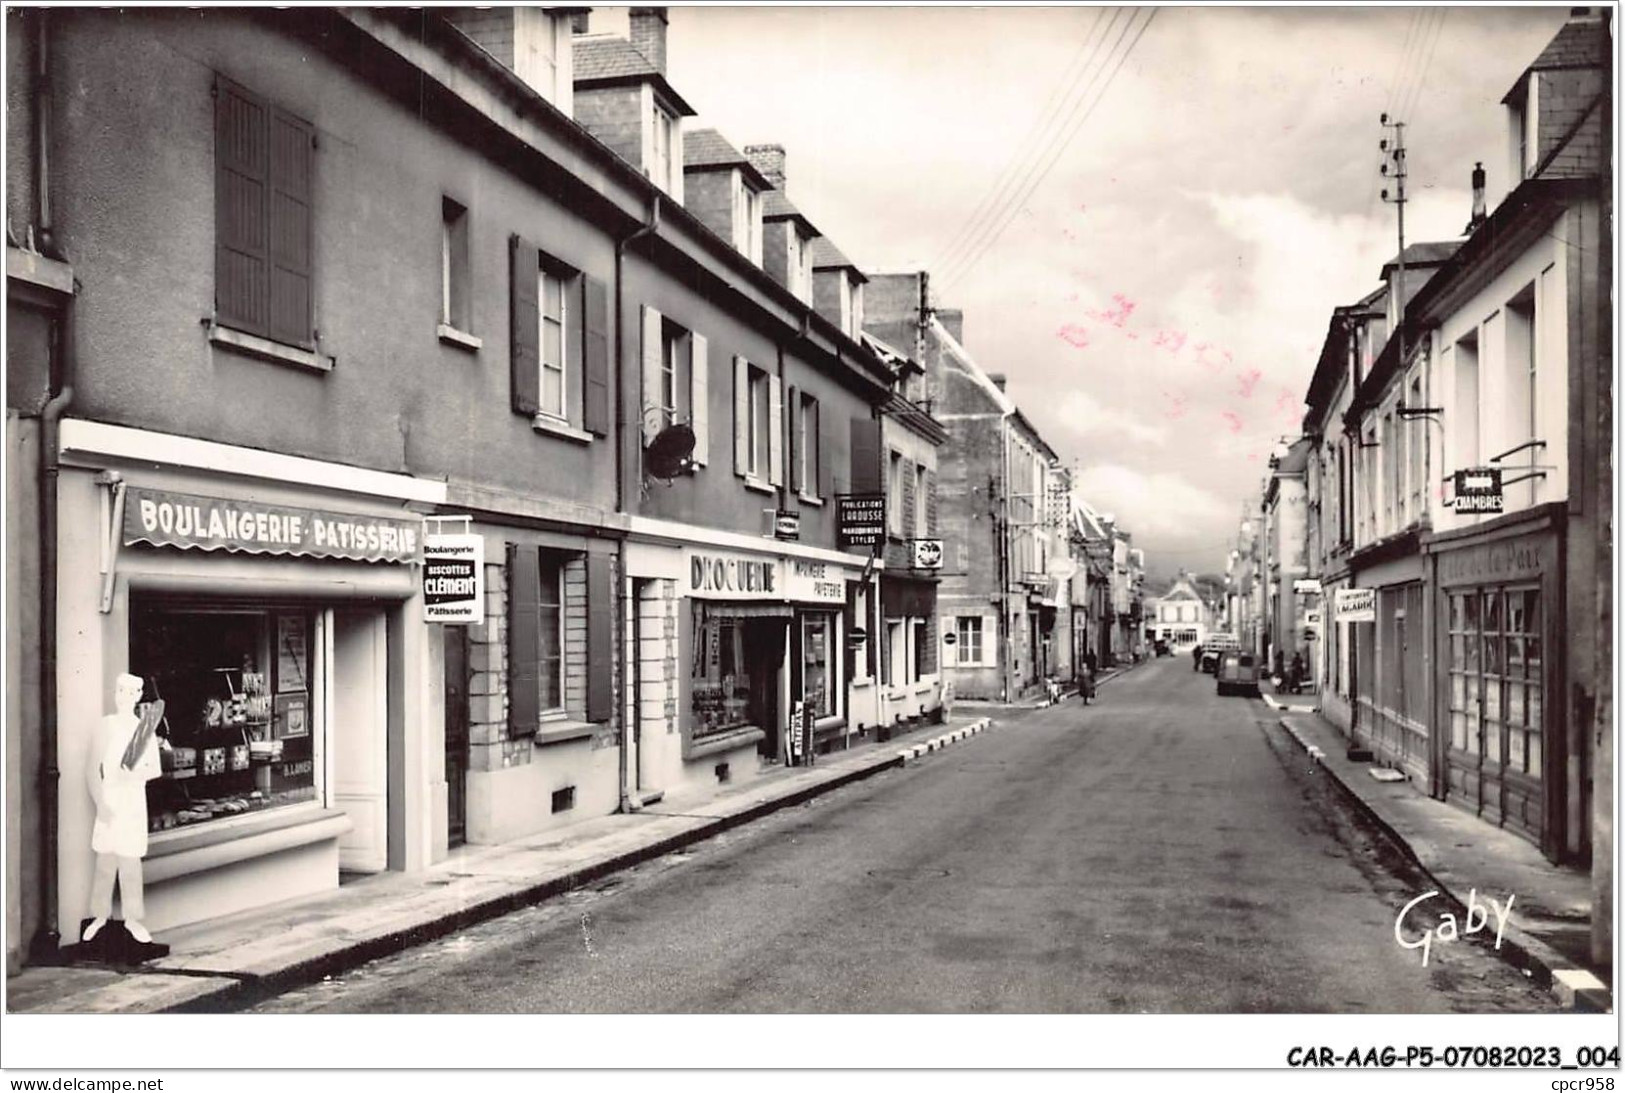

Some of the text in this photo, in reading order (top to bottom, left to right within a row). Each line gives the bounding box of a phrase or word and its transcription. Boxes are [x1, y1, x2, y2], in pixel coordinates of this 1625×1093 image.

[1455, 496, 1503, 510] CHAMBRES
[842, 510, 883, 522] LAROUSSE
[140, 499, 416, 552] BOULANGERIE PATISSERIE
[423, 546, 475, 556] Boulangerie
[428, 565, 471, 575] BISCOTTES
[427, 606, 472, 615] Pâtisserie
